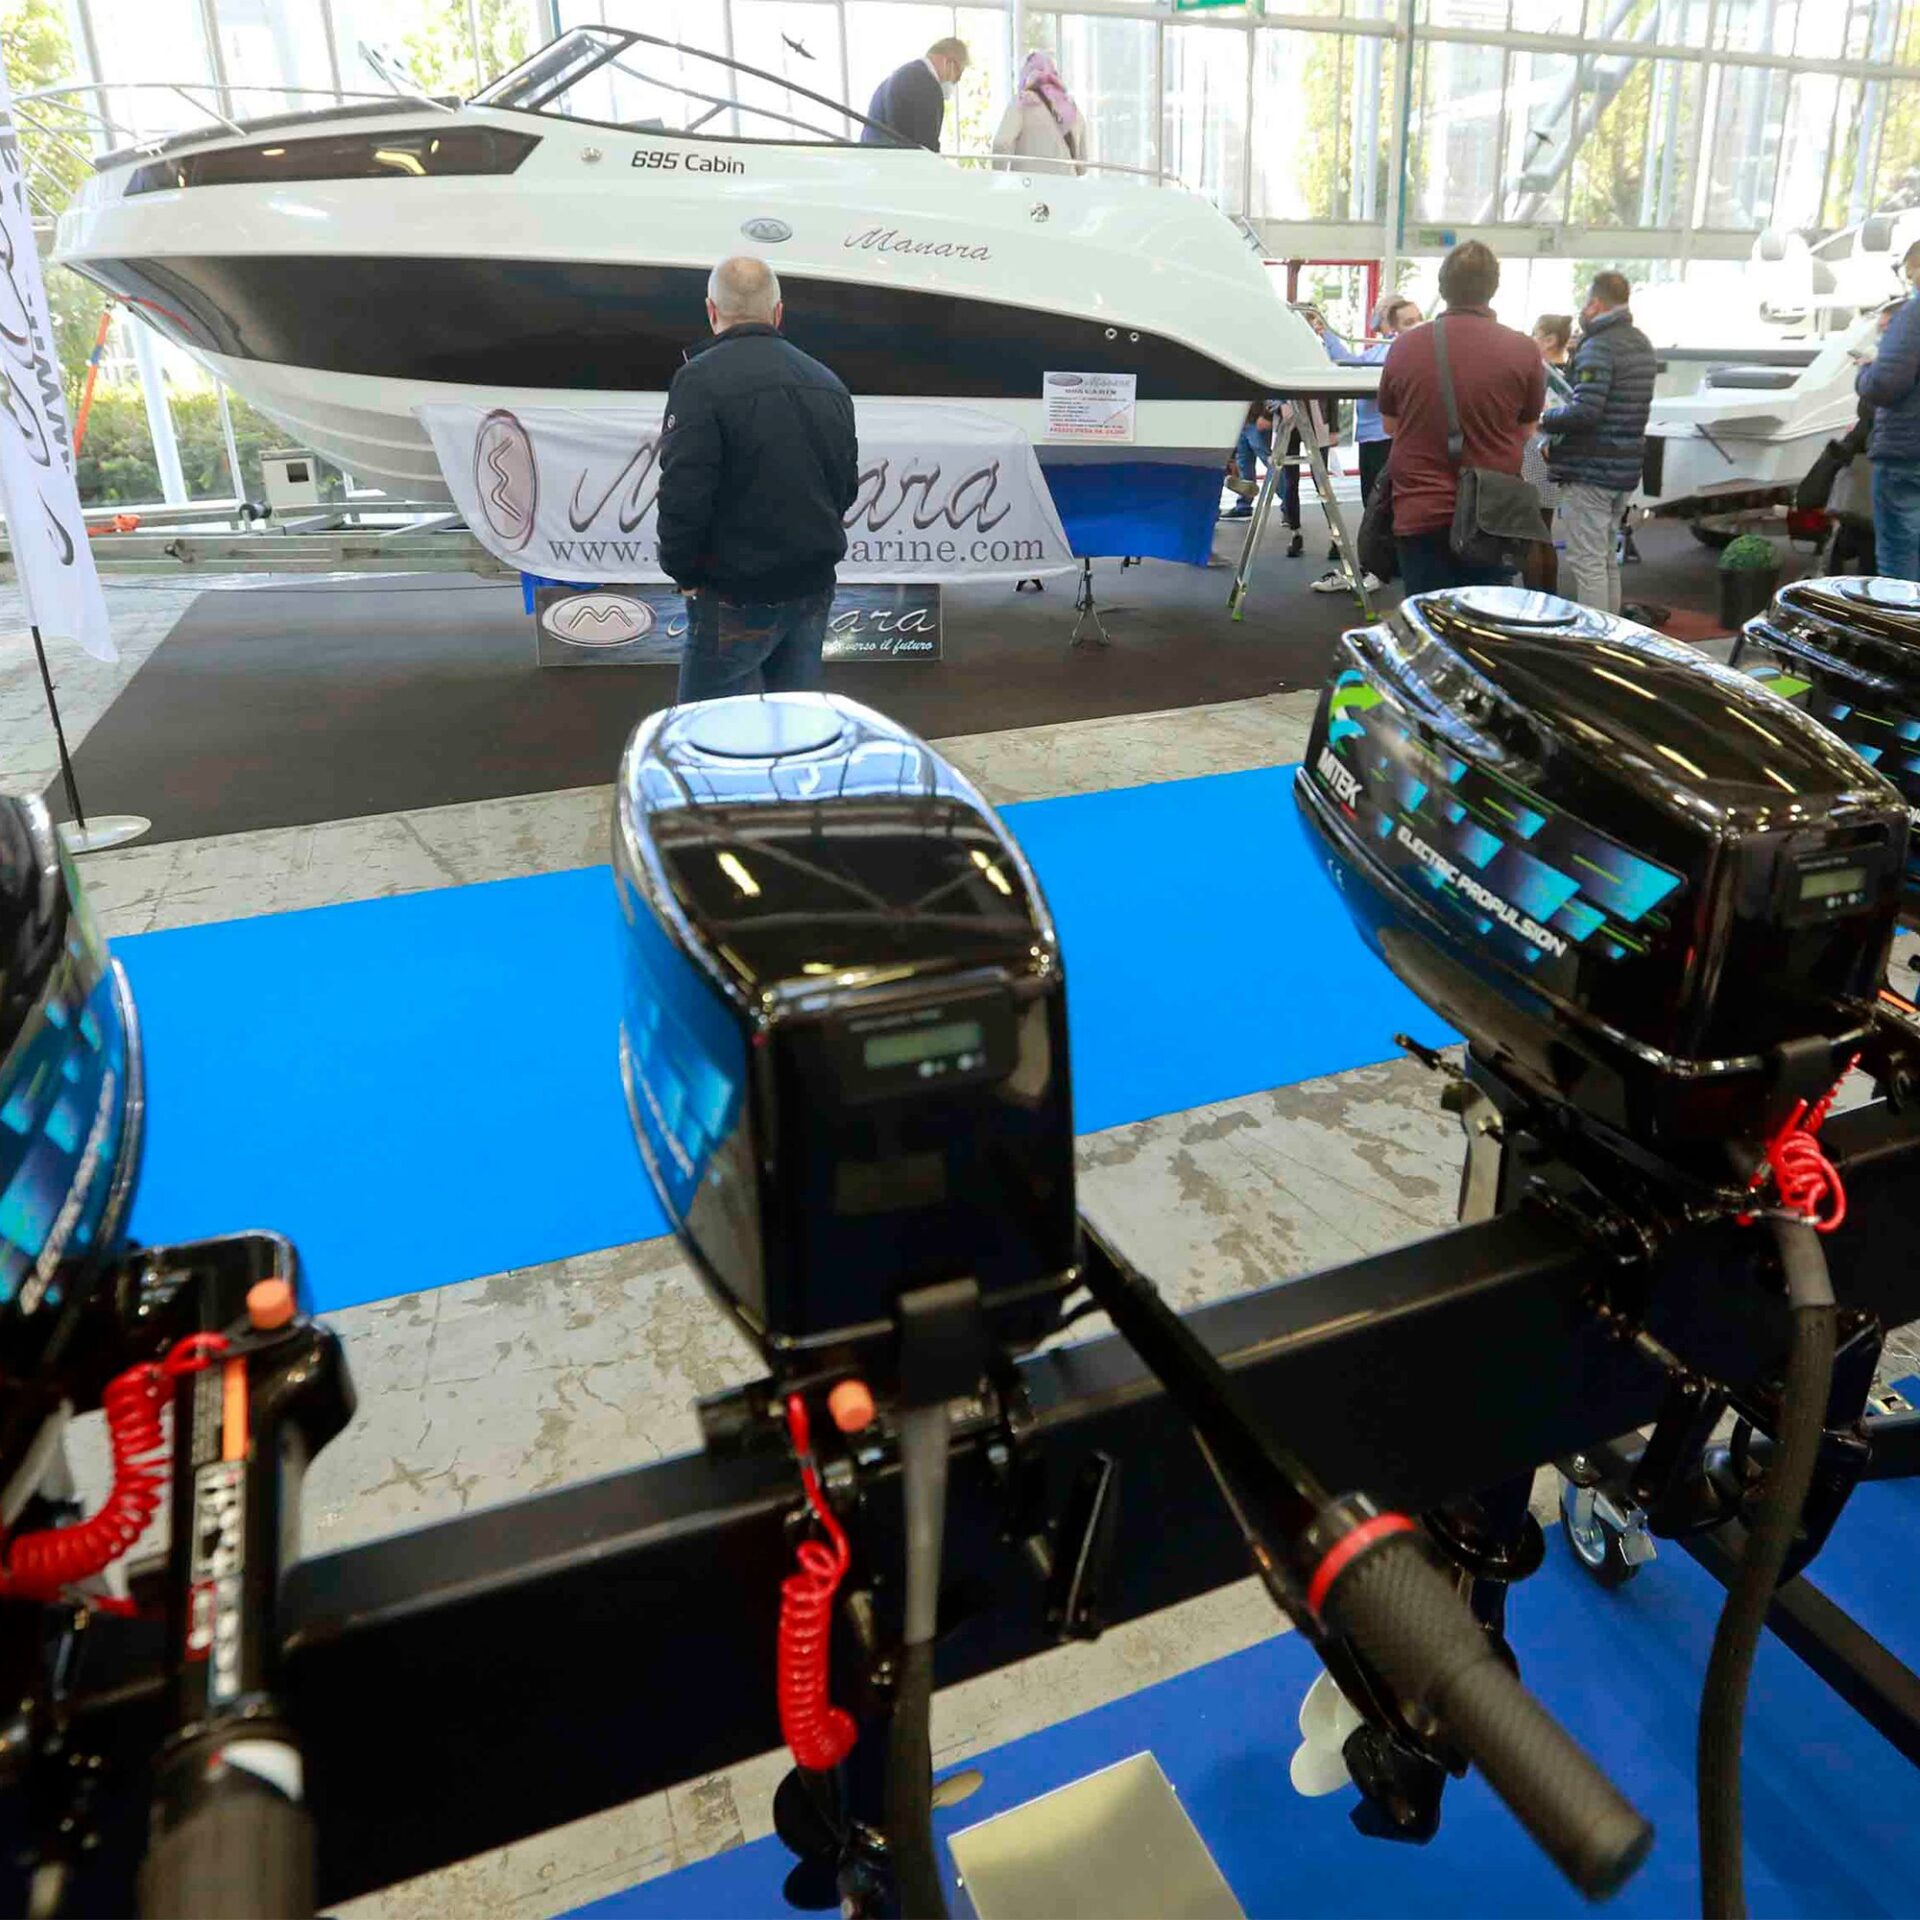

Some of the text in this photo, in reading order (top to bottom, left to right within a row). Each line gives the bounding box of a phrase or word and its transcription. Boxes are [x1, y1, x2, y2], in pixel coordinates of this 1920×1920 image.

[631, 150, 745, 174] 695 Cabin
[843, 225, 992, 262] Manara
[892, 638, 933, 655] futuro
[1317, 746, 1363, 809] MITEK
[1397, 825, 1461, 882] ELECTRIC
[1457, 873, 1567, 959] PROPULSION
